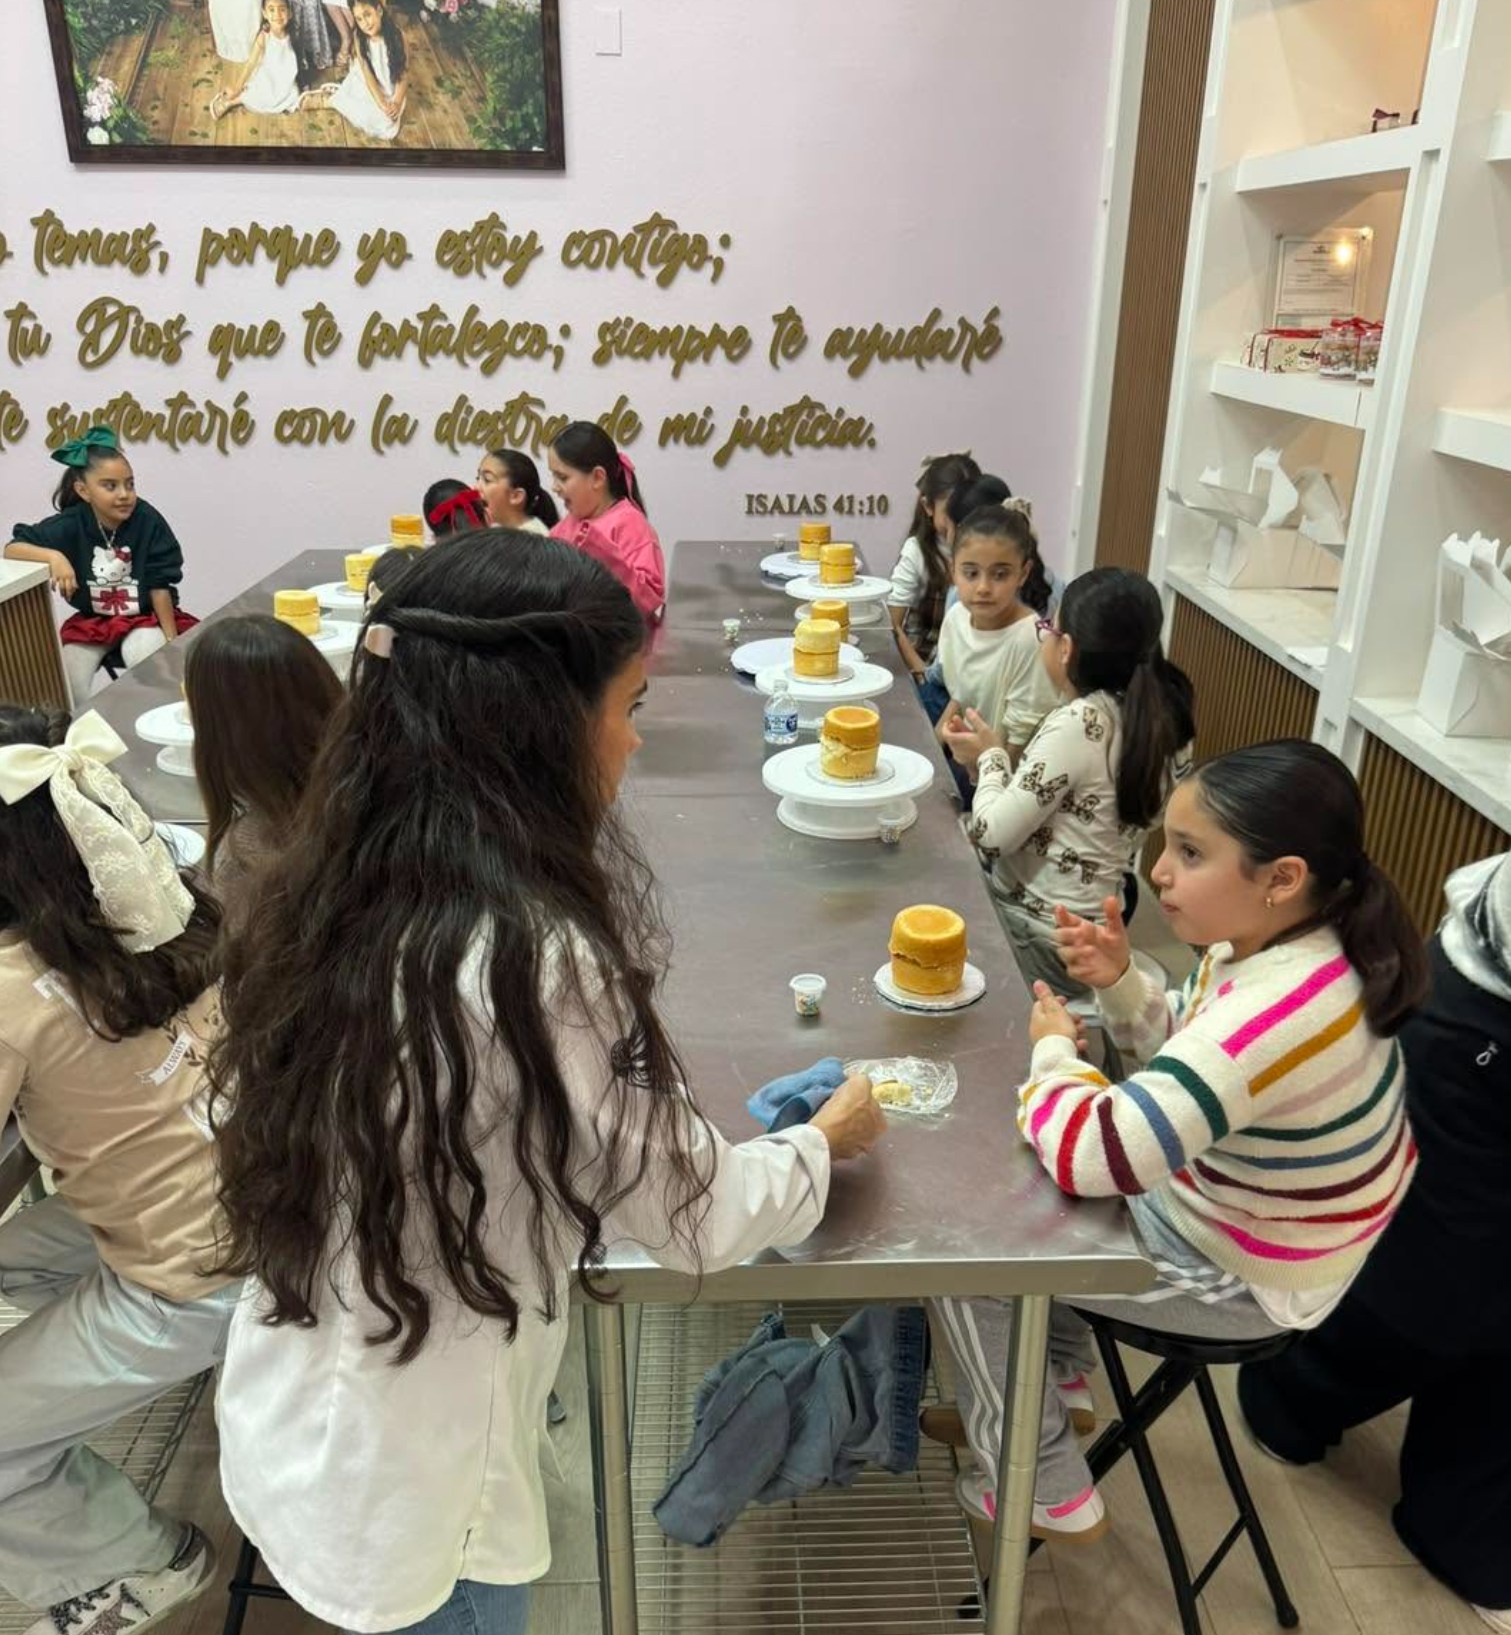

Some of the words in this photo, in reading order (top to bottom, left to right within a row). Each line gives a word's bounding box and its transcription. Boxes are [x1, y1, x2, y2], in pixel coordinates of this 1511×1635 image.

[30, 208, 169, 277] temas,
[195, 222, 341, 285] porque
[354, 228, 412, 287] yo
[435, 212, 543, 287] estoy
[561, 211, 732, 288] contigo;
[4, 301, 51, 365] tu
[76, 296, 191, 370] Dios
[208, 319, 286, 380] que
[302, 302, 342, 365] te
[357, 302, 572, 376] fortalezco;
[592, 316, 752, 379] siempre
[768, 305, 808, 369] te
[823, 306, 1004, 379] ayudaré
[274, 406, 354, 446] con
[371, 393, 419, 455] la
[434, 390, 568, 457] diestra
[597, 394, 642, 446] de
[658, 406, 714, 447] mi
[713, 395, 877, 468] justicia.
[745, 494, 828, 516] ISAIAS
[832, 494, 890, 516] 41:10
[162, 1040, 188, 1075] ALWAYS
